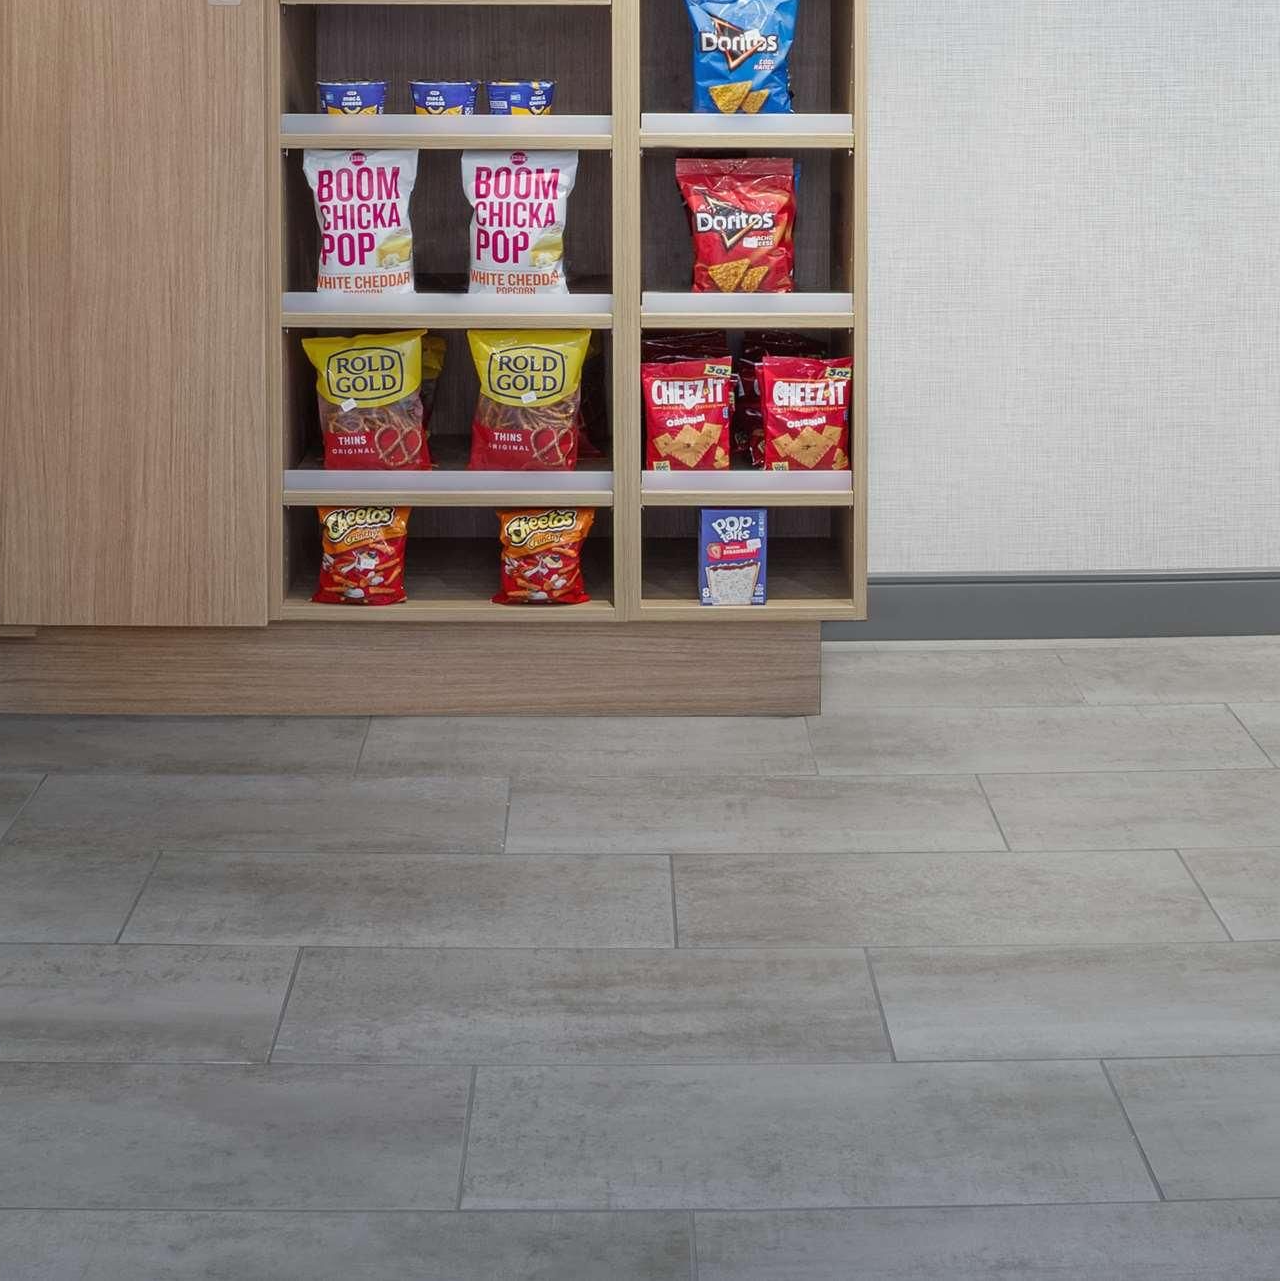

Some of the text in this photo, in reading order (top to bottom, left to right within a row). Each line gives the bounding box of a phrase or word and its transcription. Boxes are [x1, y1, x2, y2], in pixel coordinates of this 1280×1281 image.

[317, 166, 401, 203] BOOM
[474, 166, 561, 200] BOOM
[321, 201, 402, 231] CHICKA
[474, 201, 556, 229] CHICKA
[696, 211, 774, 233] Doritos
[476, 228, 529, 264] POP
[753, 234, 775, 242] ACHO
[321, 233, 376, 267] POP
[317, 271, 411, 290] WHITE CHEDDAR
[470, 269, 560, 286] WHITE CHEDDA
[336, 354, 397, 374] ROLD
[498, 354, 559, 373] ROLD
[335, 373, 397, 393] GOLD
[496, 373, 559, 392] GOLD
[338, 434, 368, 446] THINS
[494, 431, 523, 443] THINS
[332, 446, 376, 455] ORIGINAL
[325, 506, 394, 541] Cheetos
[507, 509, 577, 545] Cheetos
